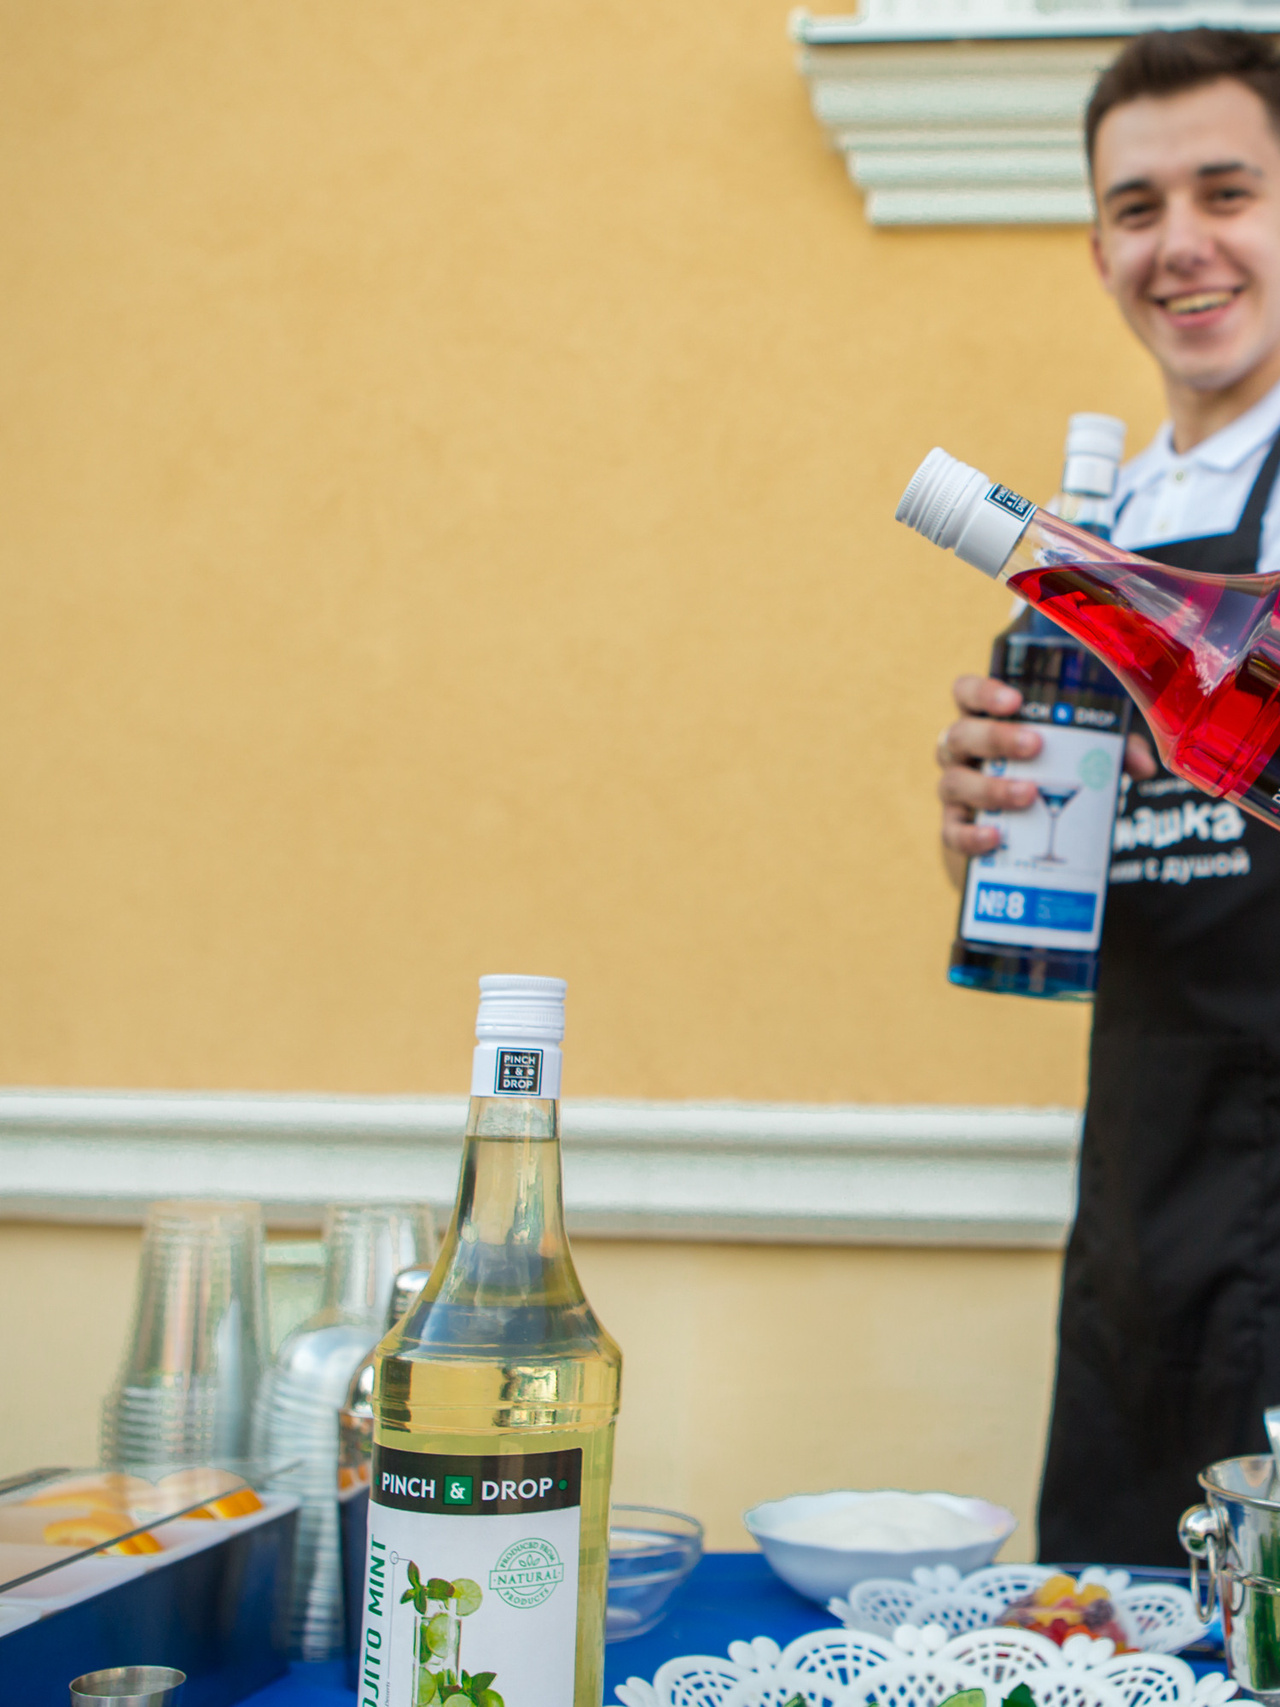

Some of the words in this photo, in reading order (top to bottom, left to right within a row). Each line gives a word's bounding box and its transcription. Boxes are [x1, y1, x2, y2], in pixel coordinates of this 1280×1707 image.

[1160, 847, 1251, 885] душой
[504, 1054, 536, 1065] PINCH
[515, 1067, 523, 1076] &
[503, 1078, 534, 1089] DROP
[381, 1472, 436, 1499] PINCH
[450, 1482, 466, 1500] &
[481, 1477, 554, 1501] DROP
[500, 1542, 539, 1568] PRODUCED
[540, 1543, 556, 1561] FROM
[367, 1533, 387, 1617] MINT
[497, 1568, 557, 1585] NATURAL
[503, 1588, 549, 1605] PRODUCTS
